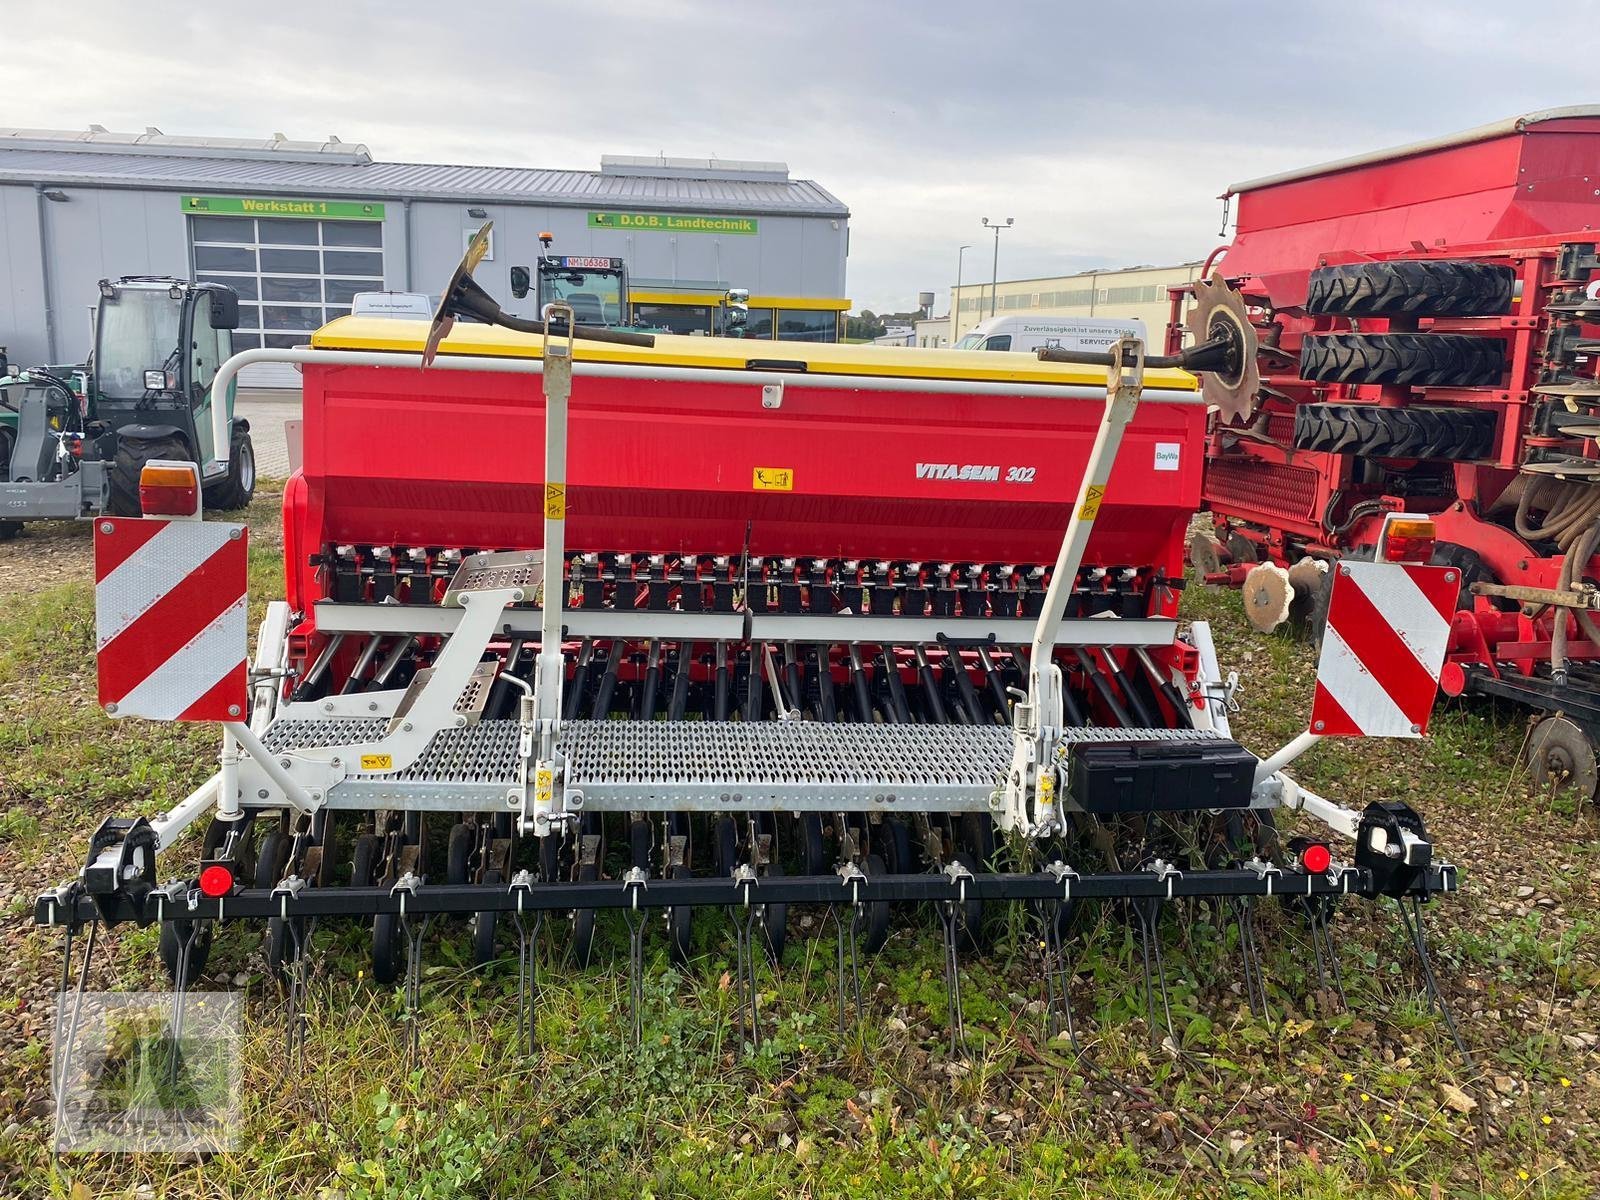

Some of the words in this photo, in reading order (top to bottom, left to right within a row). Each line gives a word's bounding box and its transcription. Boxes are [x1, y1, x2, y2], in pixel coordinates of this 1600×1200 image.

[241, 199, 315, 213] Werkstatt
[319, 203, 327, 213] 1
[620, 215, 663, 227] D.O.B.
[667, 217, 752, 231] Landtechnik
[583, 259, 609, 268] 06368
[1023, 325, 1077, 334] Zuverlässigkeit
[1156, 452, 1178, 461] BayWa
[916, 463, 1000, 482] VITASEM
[1005, 466, 1037, 484] 302
